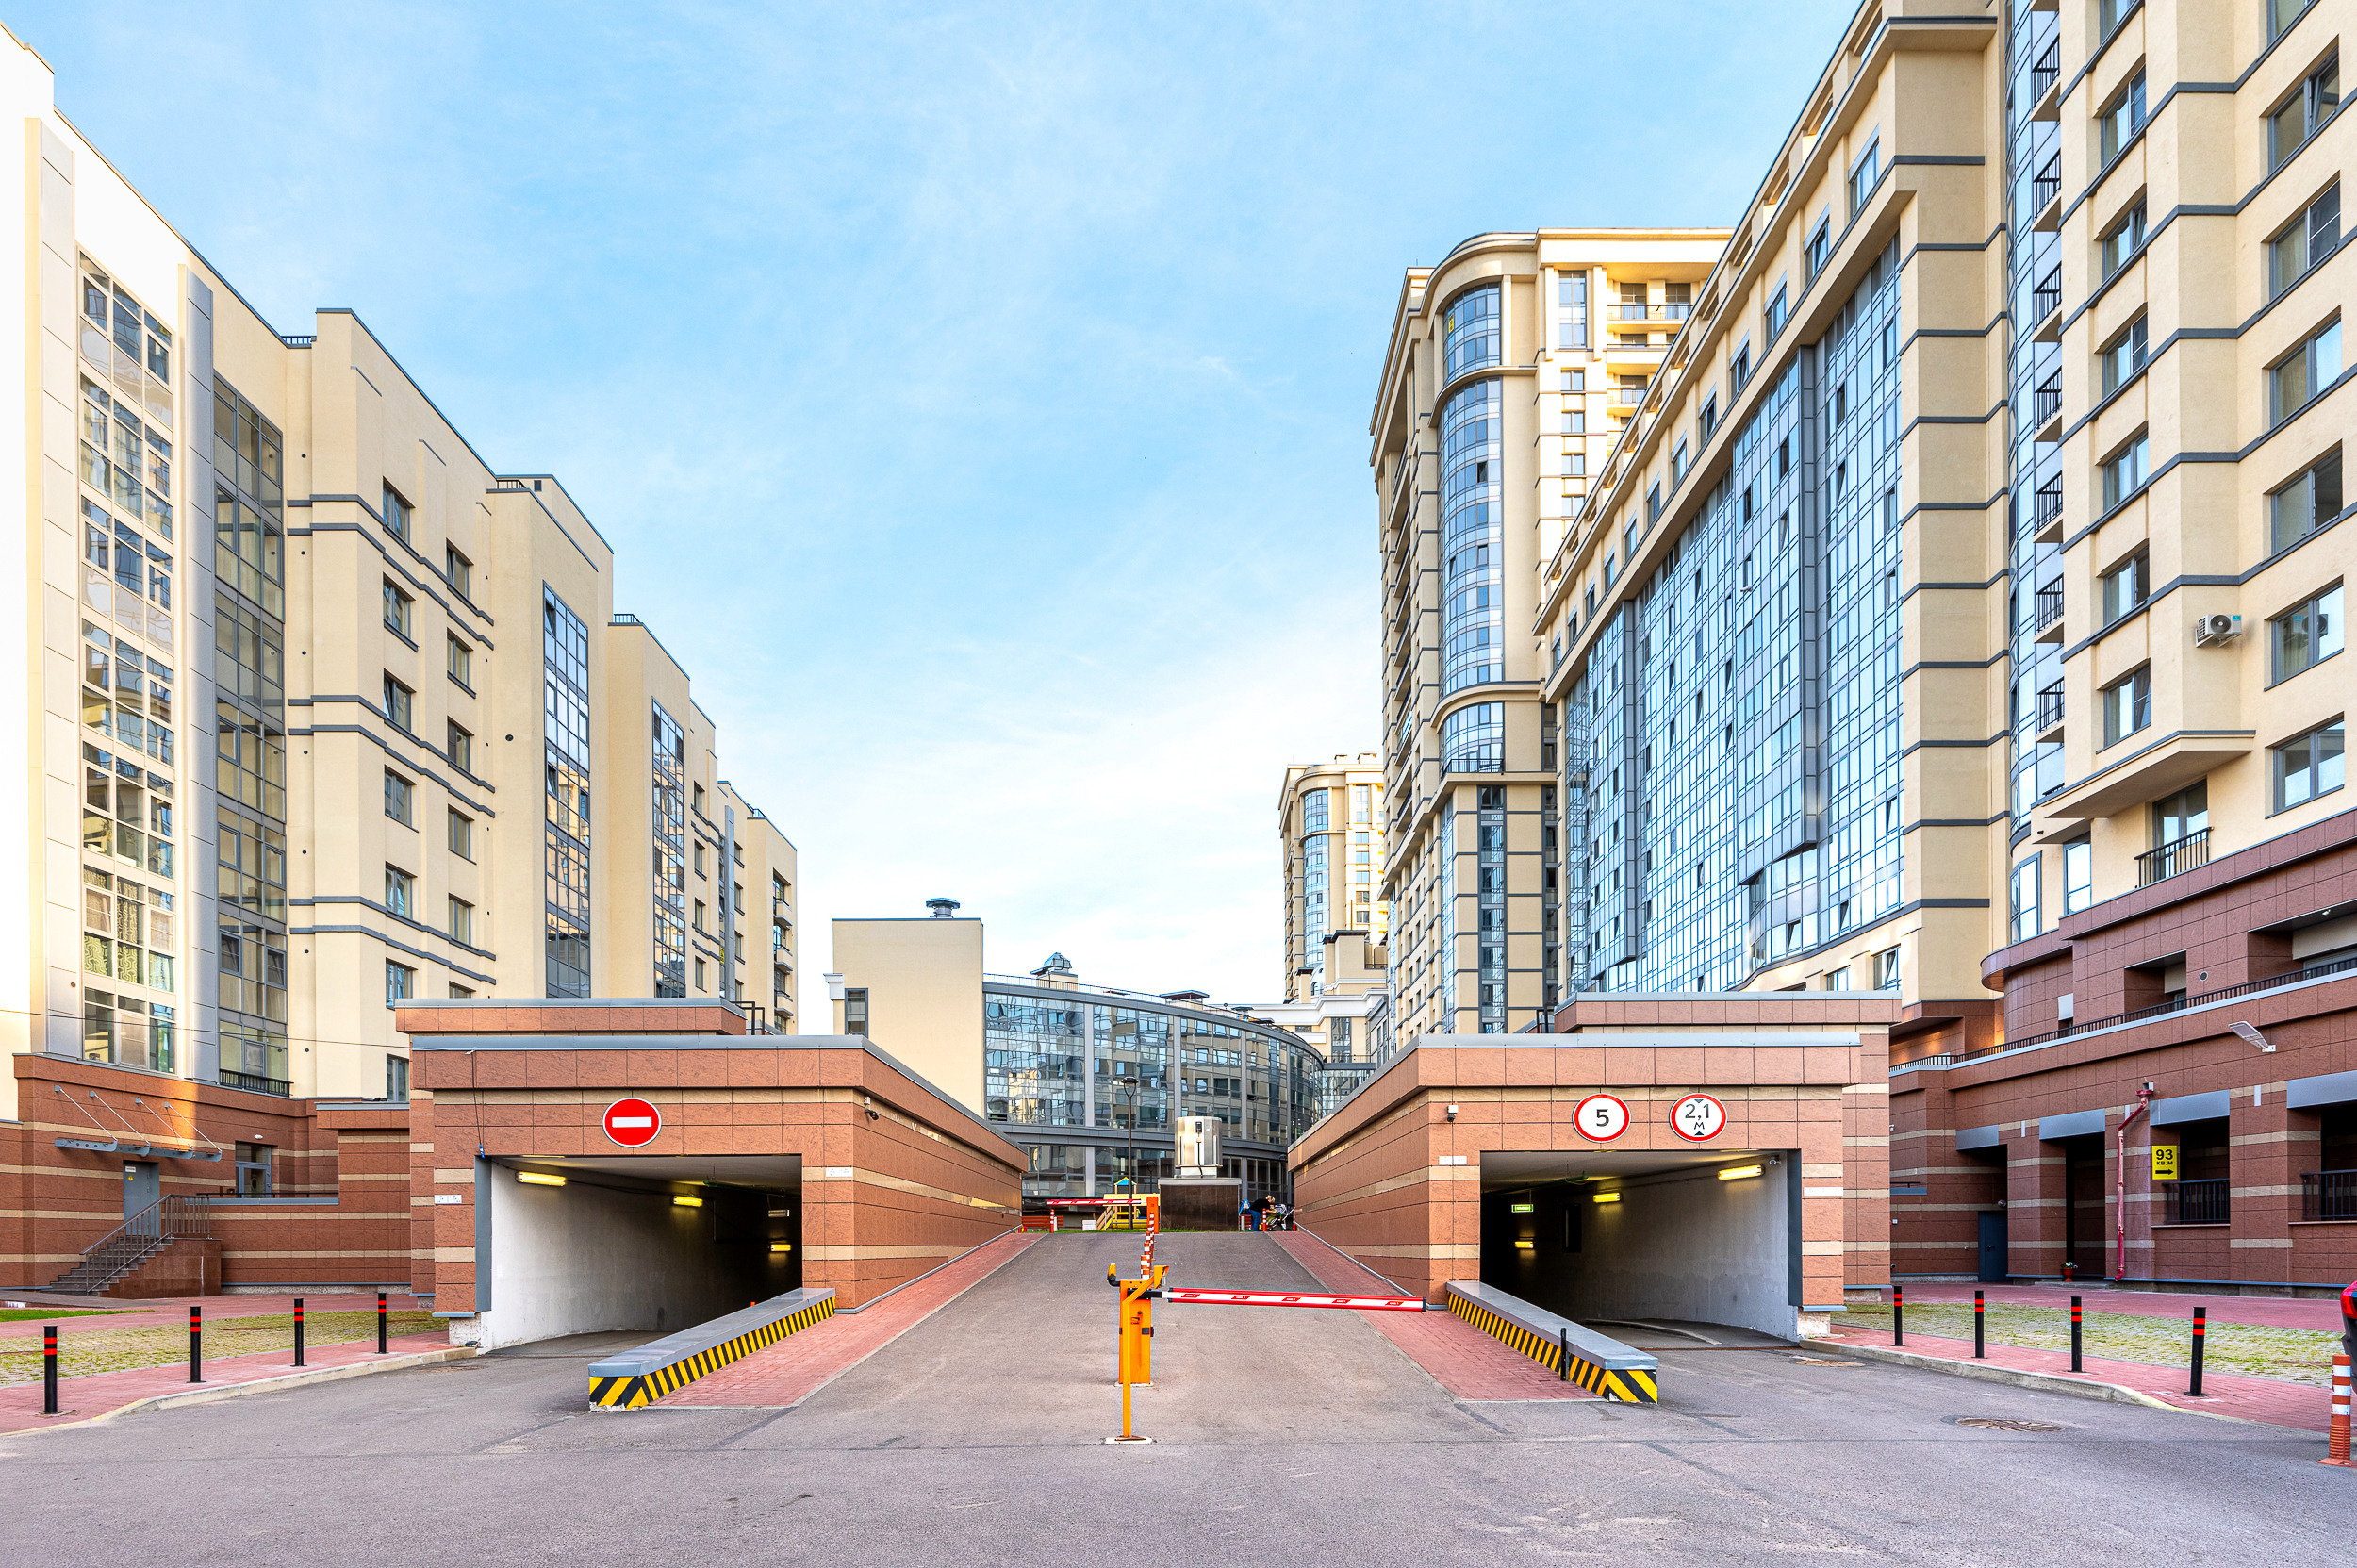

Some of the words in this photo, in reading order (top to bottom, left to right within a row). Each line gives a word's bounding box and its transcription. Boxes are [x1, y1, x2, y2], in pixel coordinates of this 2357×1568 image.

[1596, 1109, 1609, 1127] 5
[1685, 1103, 1709, 1120] 2,1
[2155, 1148, 2173, 1160] 93
